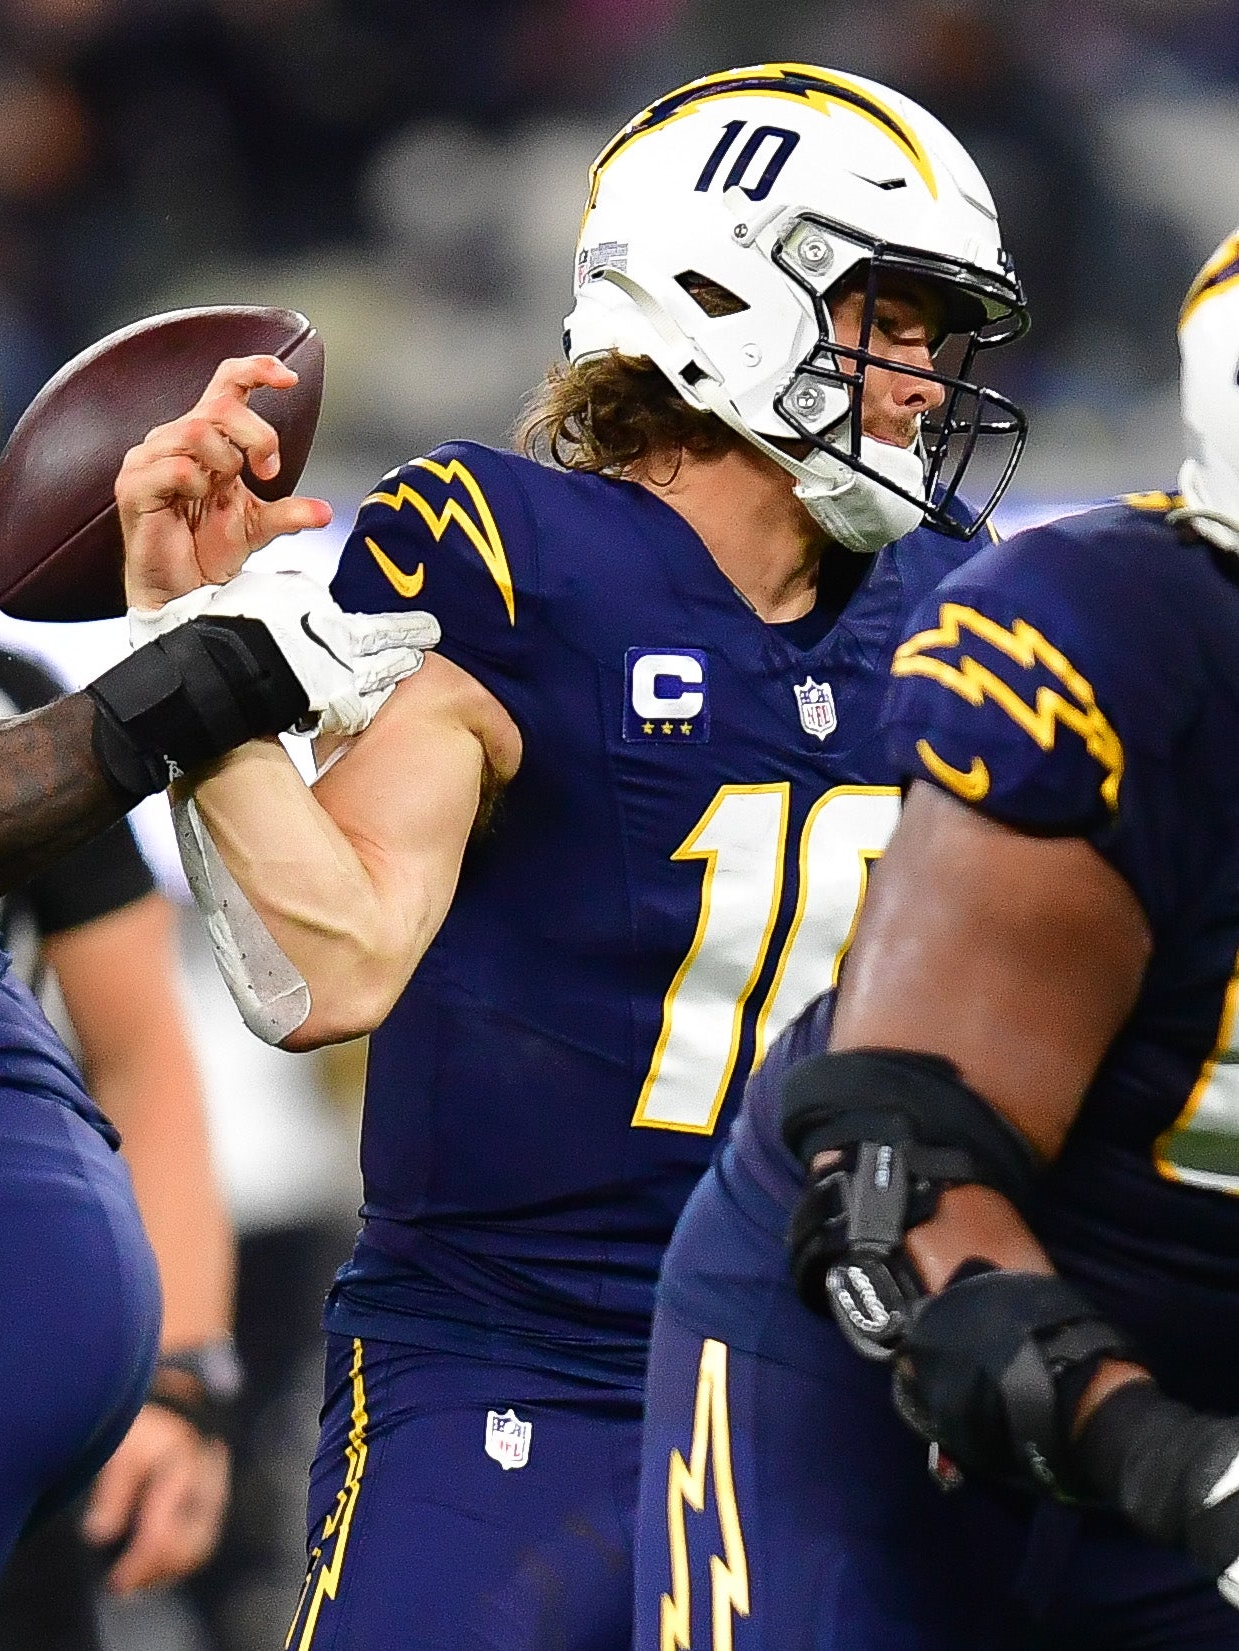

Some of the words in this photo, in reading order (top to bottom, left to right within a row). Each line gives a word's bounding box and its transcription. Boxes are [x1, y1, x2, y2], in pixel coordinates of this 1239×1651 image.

[694, 119, 801, 201] 10
[632, 654, 704, 720] C
[807, 704, 831, 728] NFL
